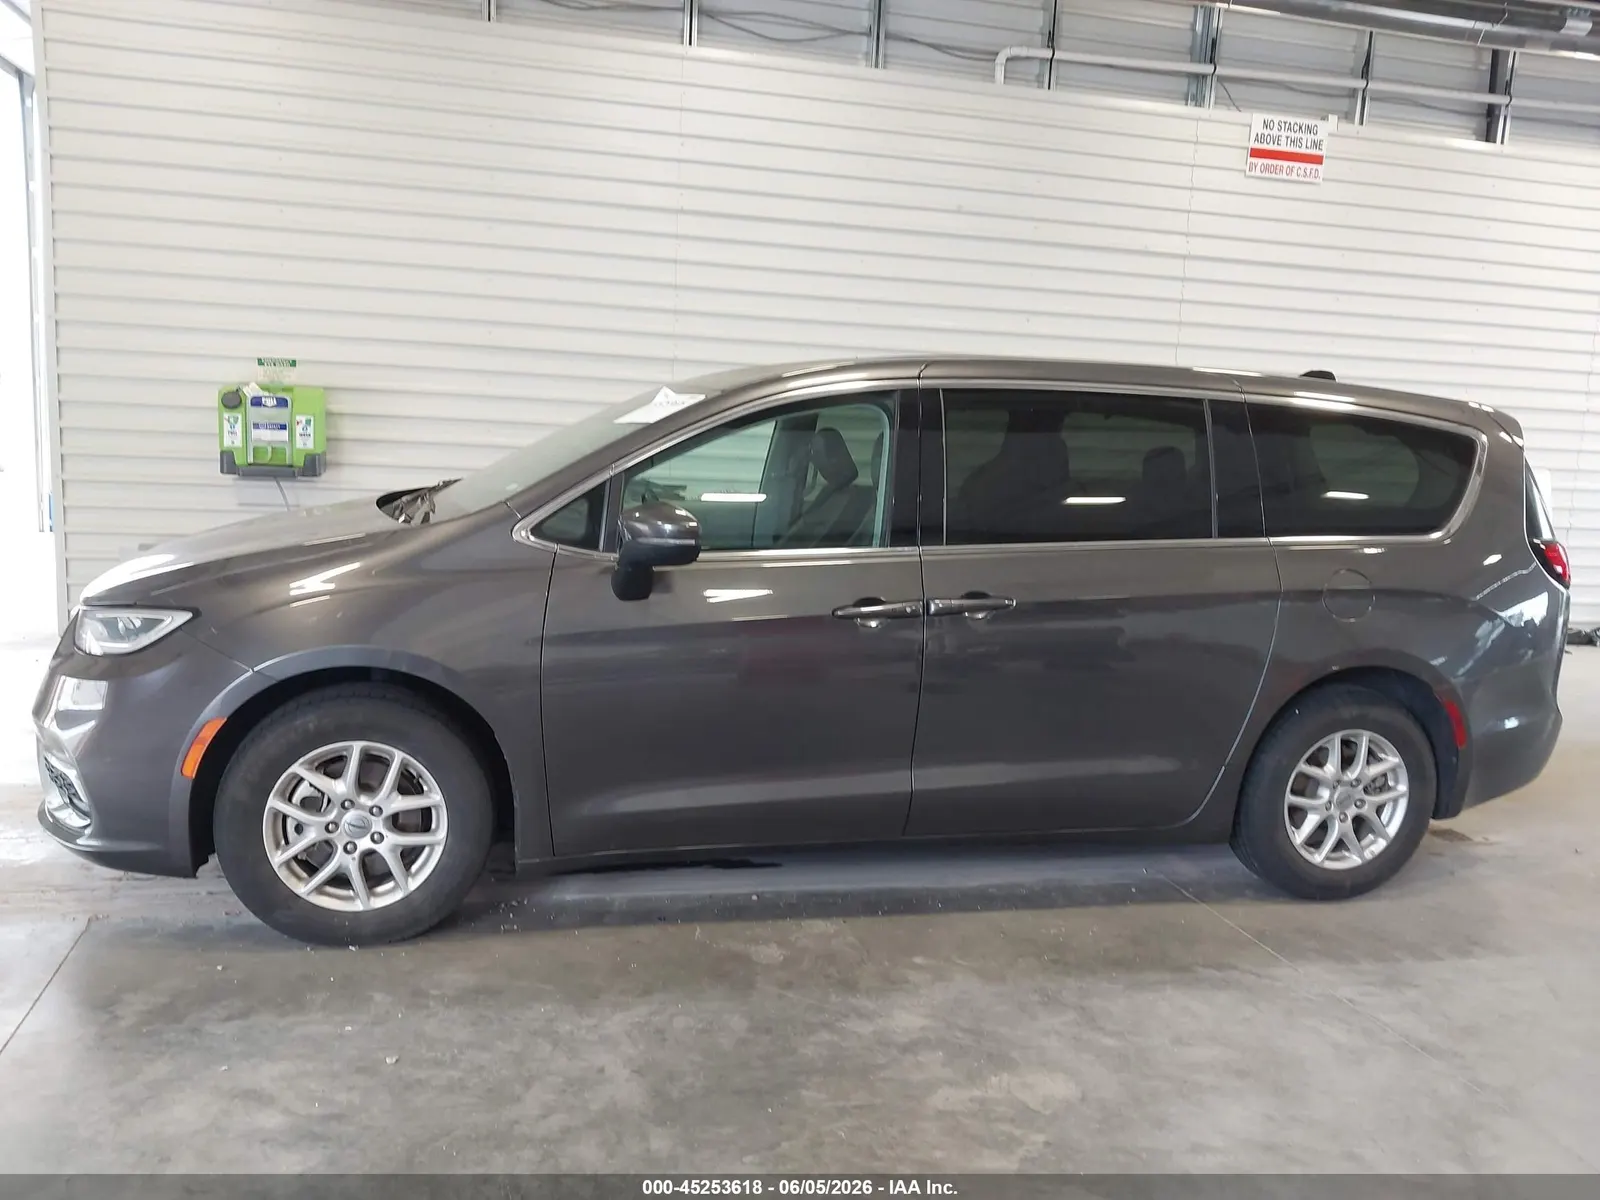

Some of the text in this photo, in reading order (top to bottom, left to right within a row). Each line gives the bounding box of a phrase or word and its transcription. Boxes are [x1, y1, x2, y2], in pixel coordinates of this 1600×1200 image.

[1262, 118, 1318, 136] NO STACKING
[1253, 132, 1324, 151] ABOVE THIS LINE
[1248, 161, 1258, 173] BY
[1260, 163, 1284, 176] ORDER
[1285, 165, 1295, 177] OF
